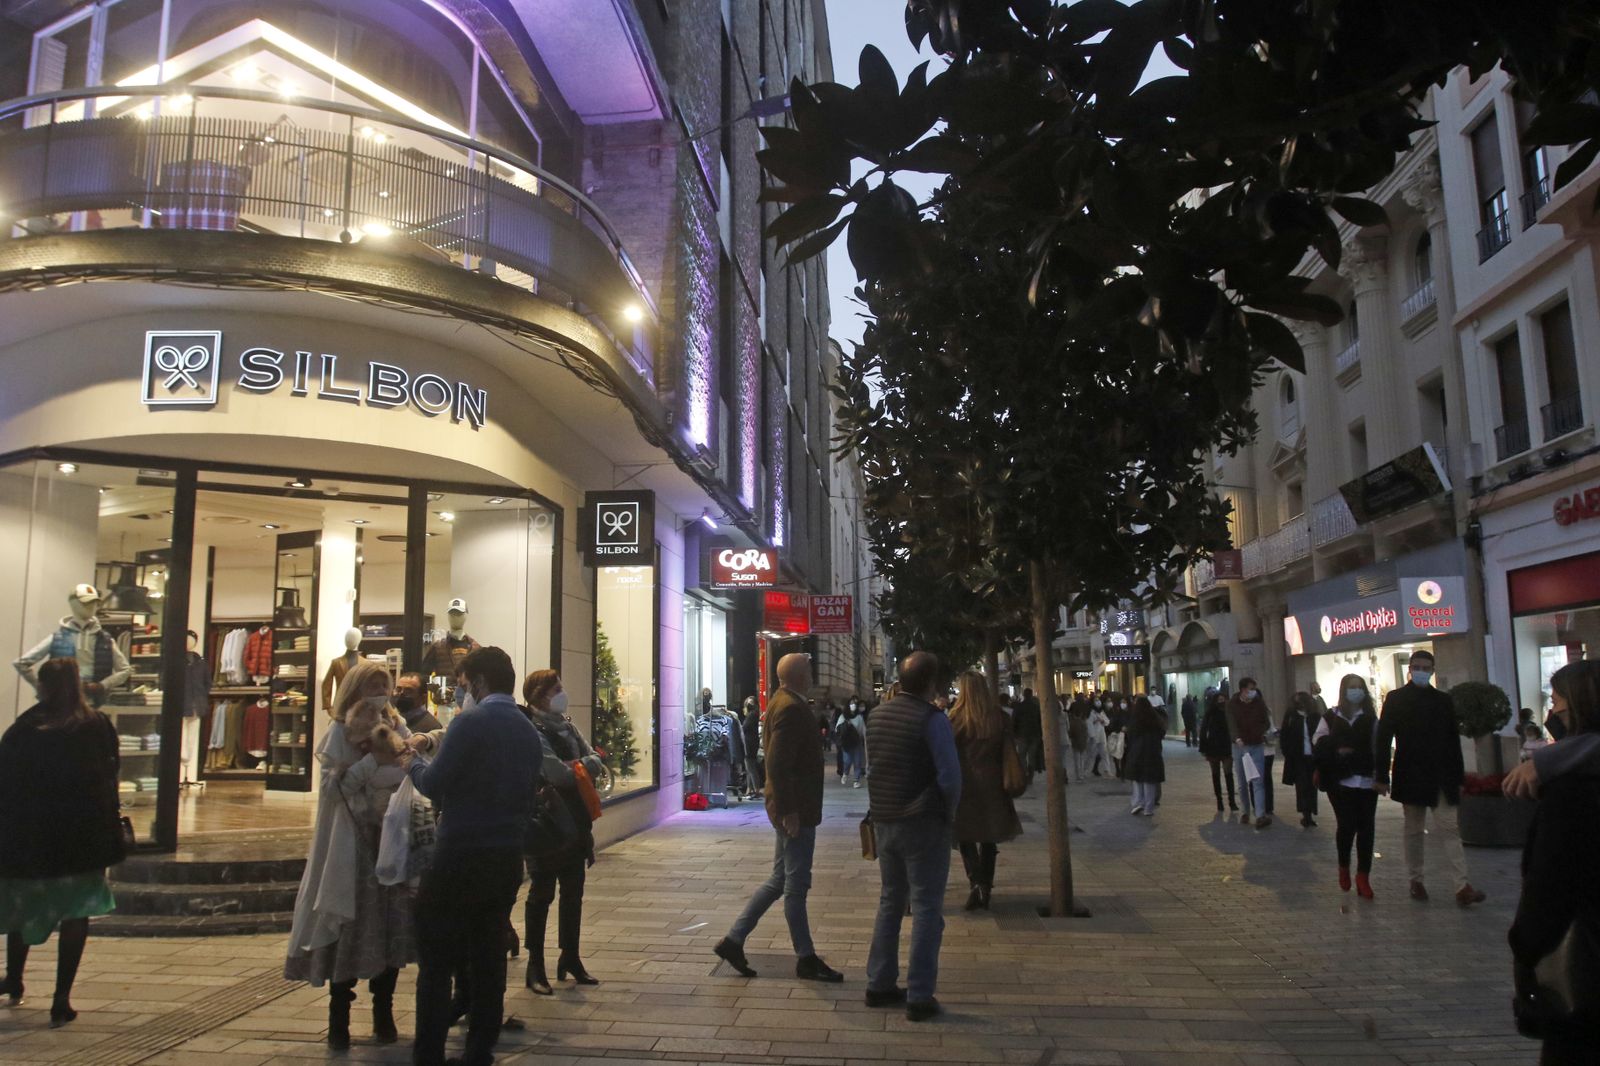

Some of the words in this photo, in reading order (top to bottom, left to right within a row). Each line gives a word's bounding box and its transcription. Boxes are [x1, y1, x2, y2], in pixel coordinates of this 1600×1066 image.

[238, 347, 488, 428] SILBON
[596, 546, 639, 555] SILBON
[718, 549, 771, 571] CORA
[731, 572, 758, 581] Susan
[791, 594, 808, 608] GAN
[814, 597, 849, 606] BAZAR
[817, 606, 845, 617] GAN
[1408, 606, 1455, 617] General
[1332, 612, 1365, 636] General
[1366, 607, 1398, 633] Optica
[1412, 616, 1452, 629] Optica
[1109, 648, 1142, 656] LUQUE
